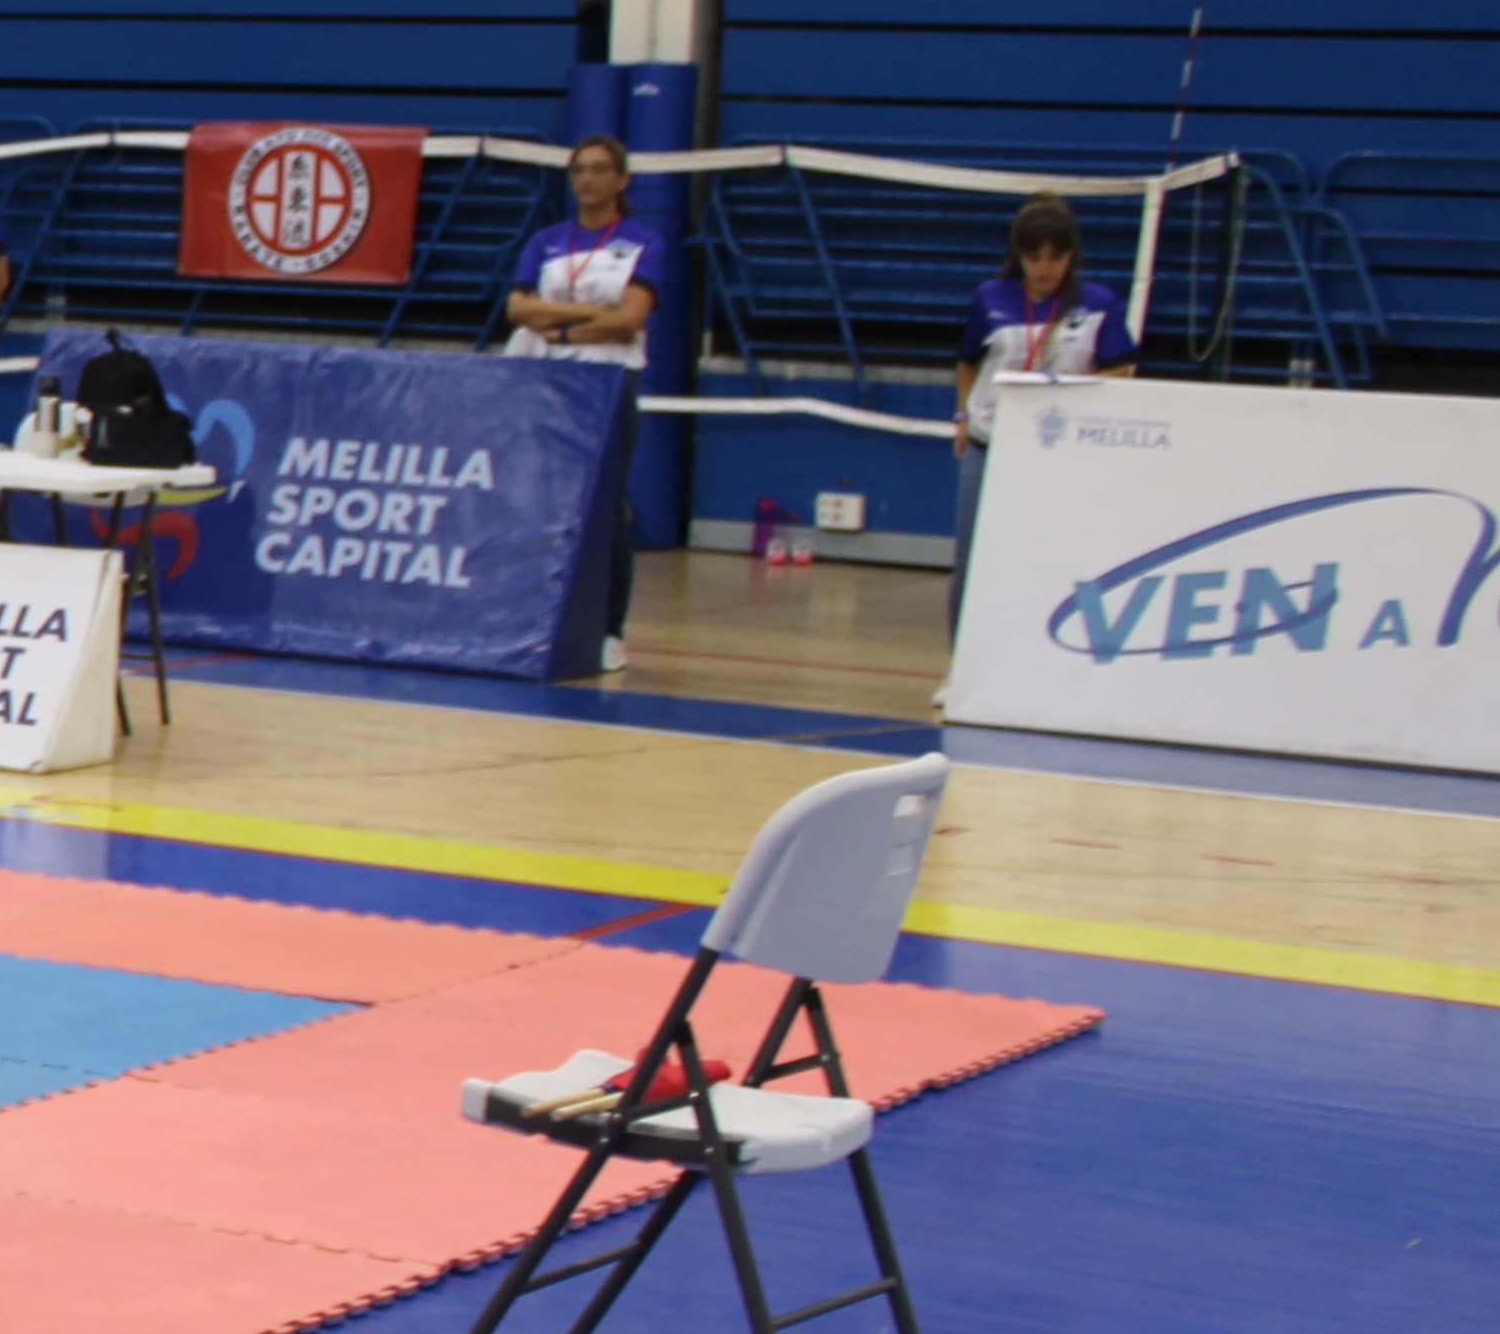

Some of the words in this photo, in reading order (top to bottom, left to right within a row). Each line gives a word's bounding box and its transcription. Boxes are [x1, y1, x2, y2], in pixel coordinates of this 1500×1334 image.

[277, 436, 495, 491] MELILLA
[266, 483, 449, 536] SPORT
[254, 531, 472, 588] CAPITAL
[1073, 562, 1341, 665] VEN
